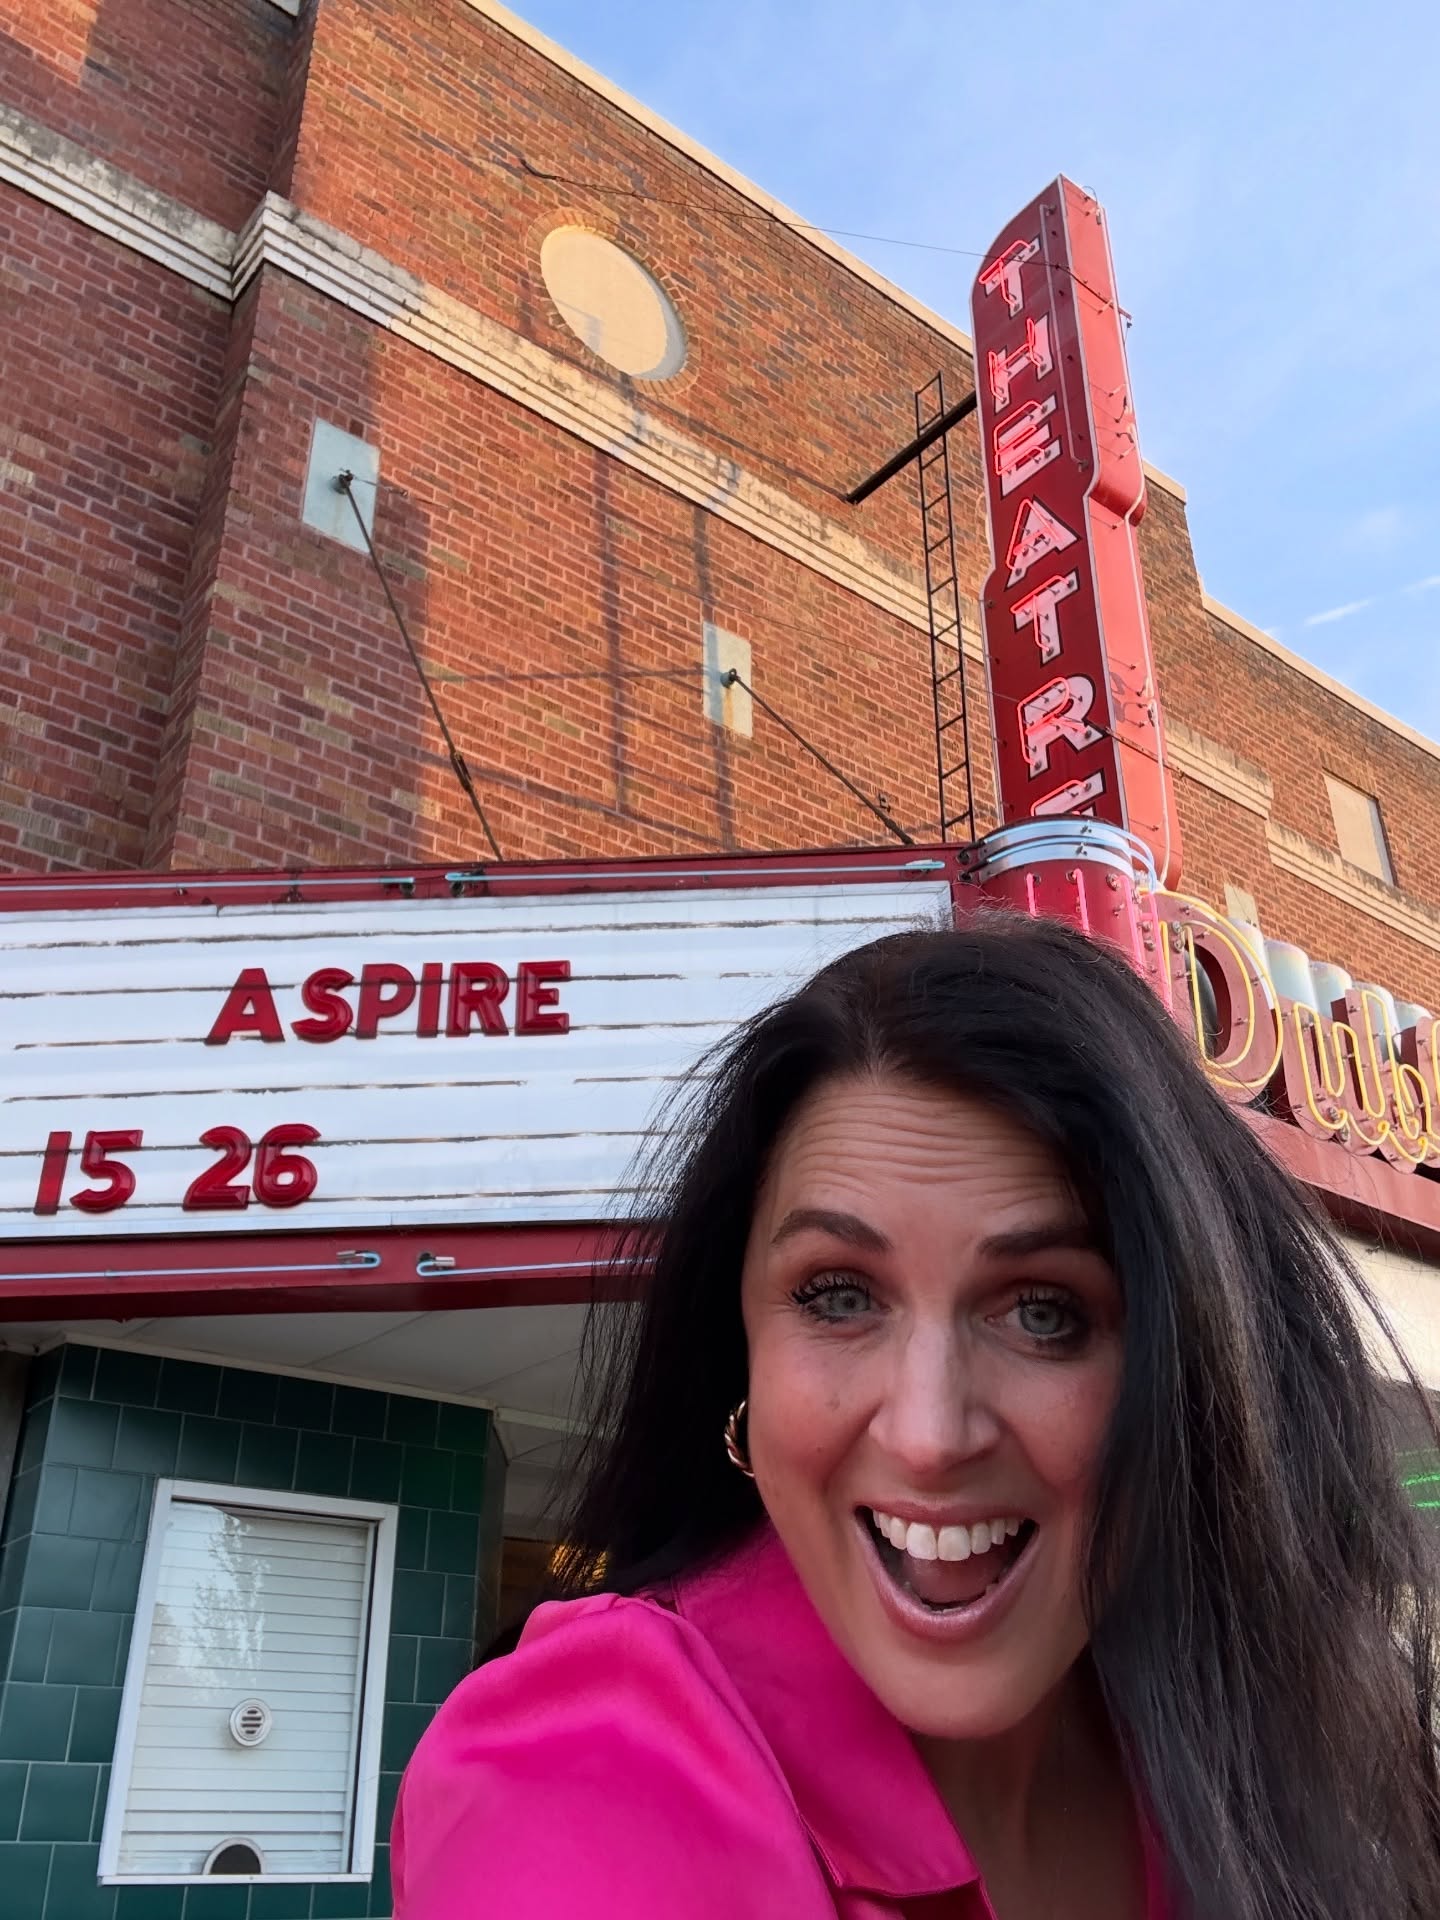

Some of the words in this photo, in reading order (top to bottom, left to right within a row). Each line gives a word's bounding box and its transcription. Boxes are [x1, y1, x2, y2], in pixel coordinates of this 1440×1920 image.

[204, 959, 571, 1046] ASPIRE
[33, 1129, 144, 1216] 15
[182, 1122, 322, 1213] 26
